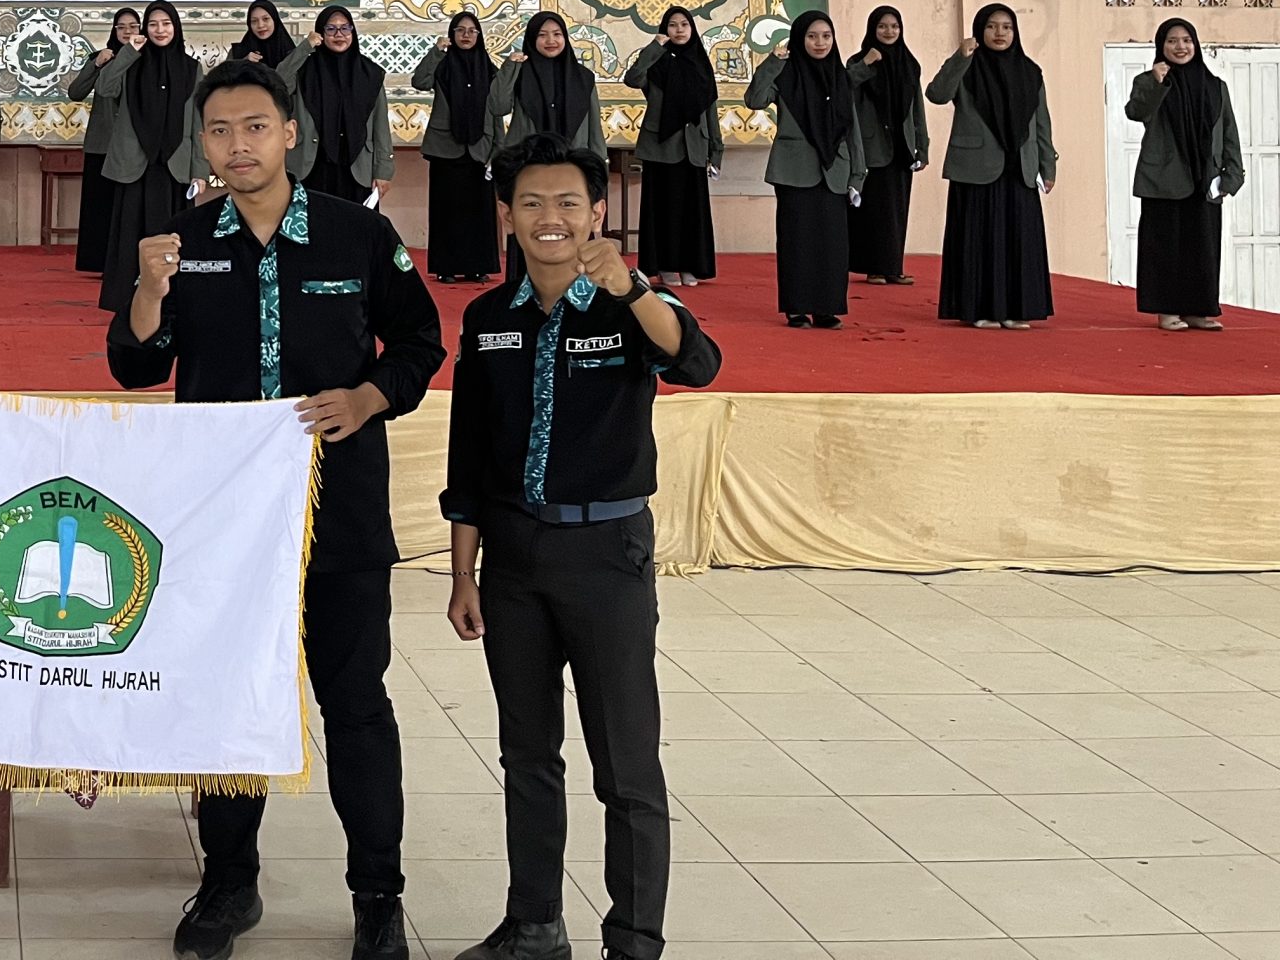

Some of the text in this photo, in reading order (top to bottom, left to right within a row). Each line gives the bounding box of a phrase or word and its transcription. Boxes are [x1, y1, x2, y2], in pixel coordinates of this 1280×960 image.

[575, 338, 614, 350] KETUA
[39, 491, 97, 512] BEM
[39, 667, 93, 687] DARUL
[102, 670, 160, 691] HIJRAH
